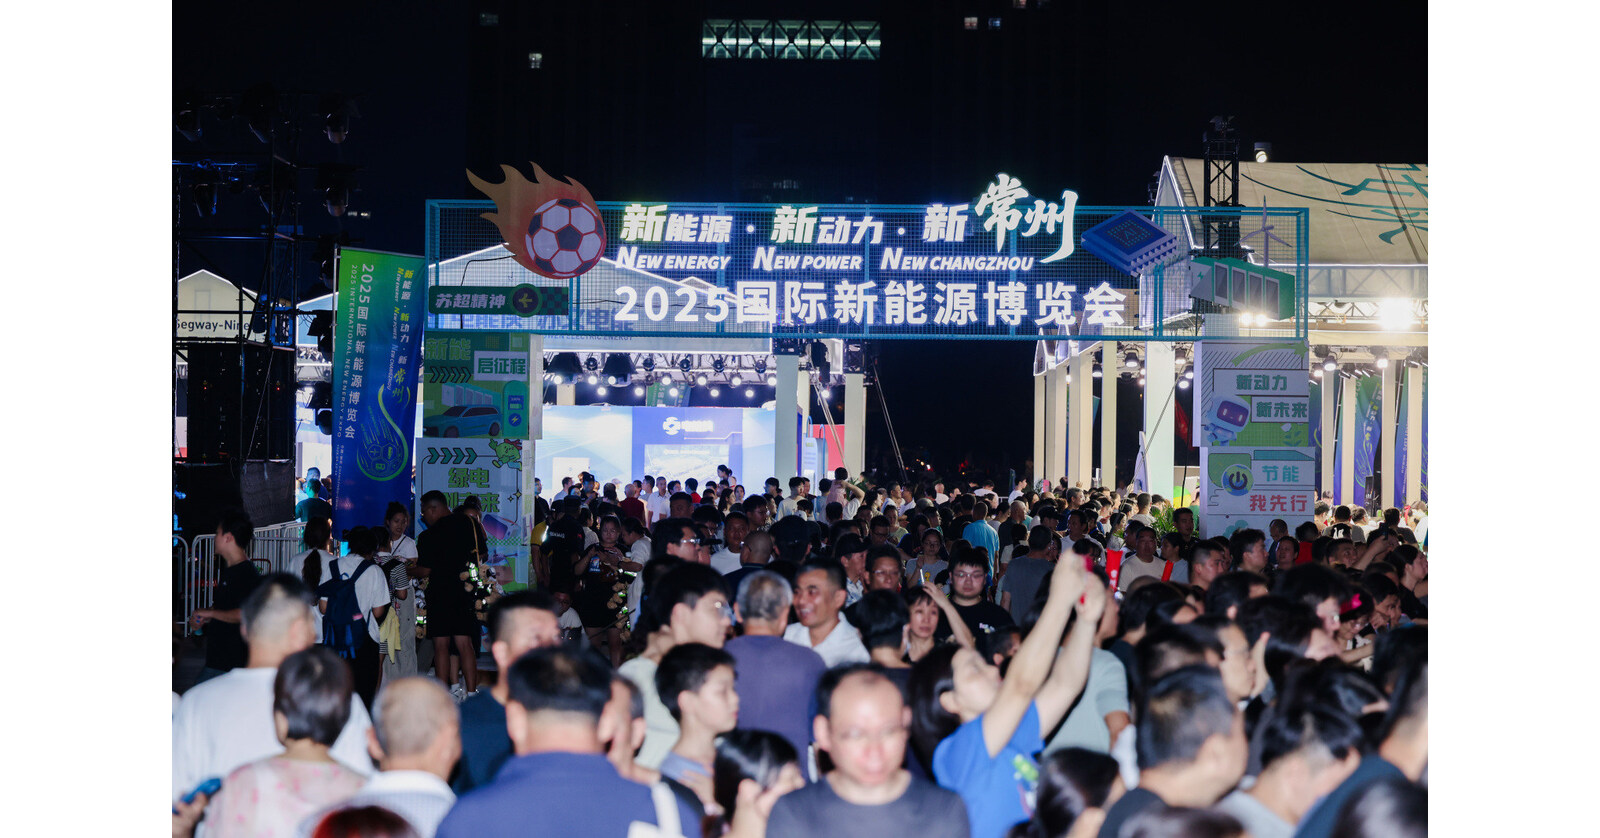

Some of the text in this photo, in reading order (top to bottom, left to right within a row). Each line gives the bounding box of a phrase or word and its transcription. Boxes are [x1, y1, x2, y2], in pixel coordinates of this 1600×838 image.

[615, 246, 1034, 270] NEW ENERGY NEW POWER NEW CHANGZHOU
[435, 293, 506, 309] 苏超精神
[614, 280, 1127, 326] 2025国际新能源博览会
[477, 357, 528, 375] 启征程
[1236, 374, 1288, 391] 新动力
[1256, 401, 1308, 418] 新未来
[447, 467, 490, 489] 绿电
[1262, 465, 1300, 483] 节能
[1250, 494, 1308, 513] 我先行
